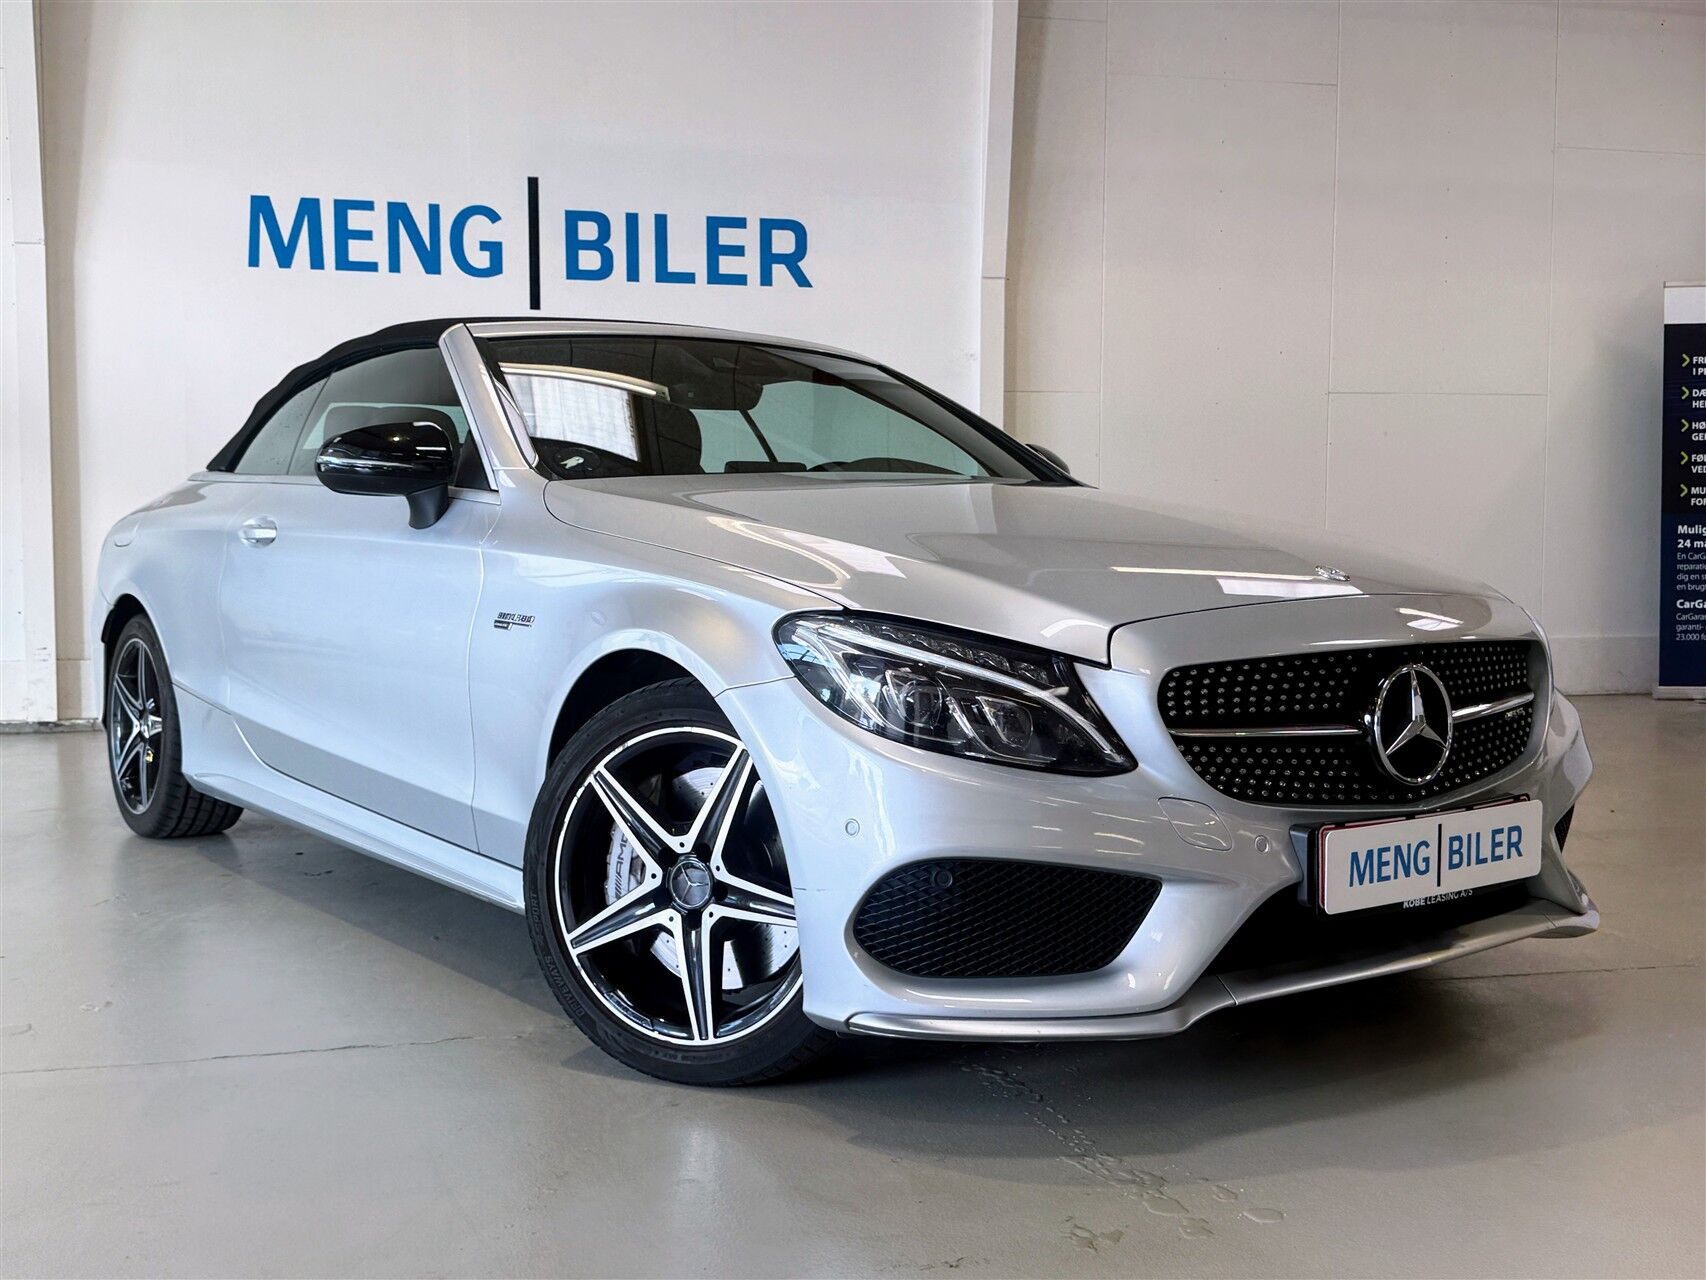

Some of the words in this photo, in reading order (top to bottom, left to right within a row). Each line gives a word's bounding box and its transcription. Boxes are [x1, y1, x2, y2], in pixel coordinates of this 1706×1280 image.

[247, 194, 503, 279] MENG
[565, 209, 814, 288] BILER
[1692, 400, 1706, 409] HE
[1691, 432, 1706, 441] GE
[1677, 539, 1691, 548] 24
[1693, 539, 1706, 548] m
[1349, 839, 1431, 888] MENG
[1448, 824, 1524, 871] BILER
[1402, 897, 1427, 909] KOBE
